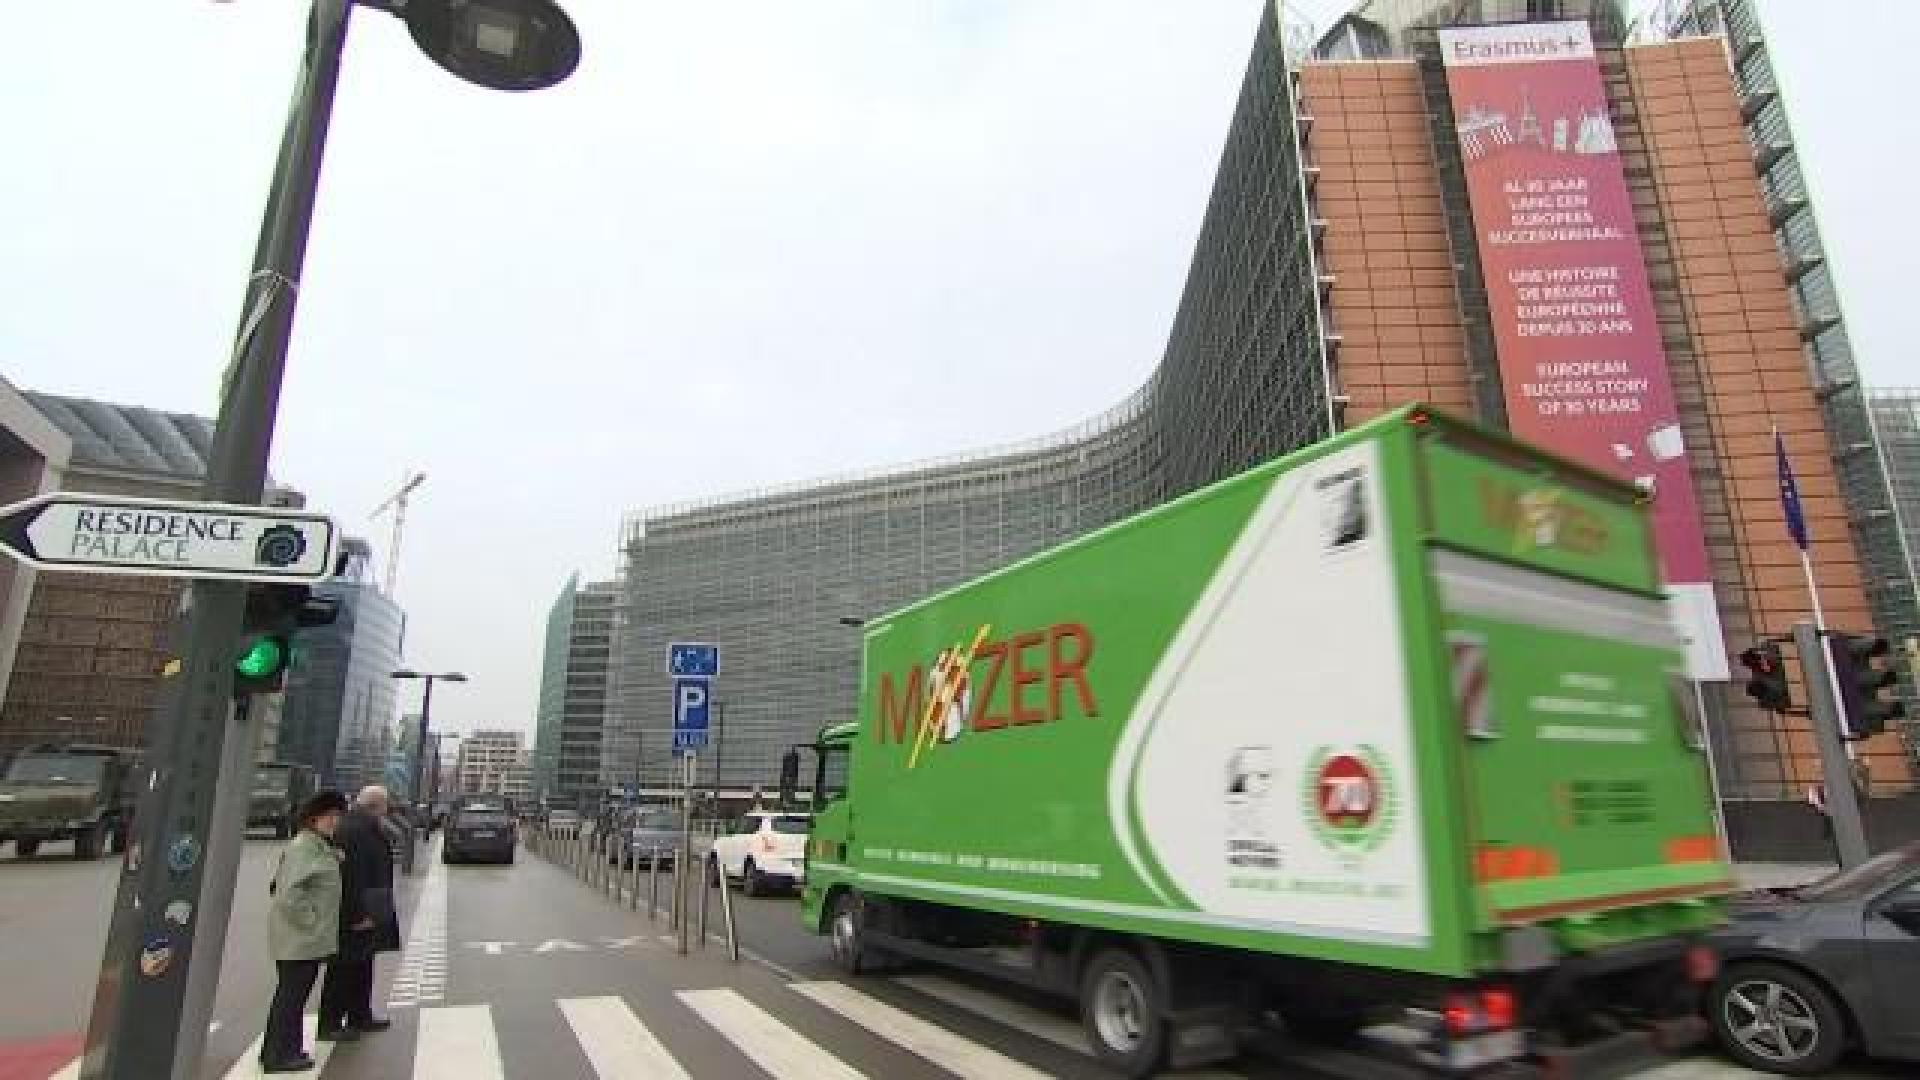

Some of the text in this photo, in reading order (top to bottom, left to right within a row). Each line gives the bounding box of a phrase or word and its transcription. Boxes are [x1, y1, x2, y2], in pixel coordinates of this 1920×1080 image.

[1454, 35, 1581, 58] Erasmus+
[1599, 319, 1632, 333] ANS
[1536, 361, 1628, 376] EUROPEAN
[1522, 382, 1593, 397] SUCCESS
[1538, 402, 1559, 415] OF
[1586, 398, 1640, 412] YEARS
[76, 509, 247, 541] RESIDENCE
[72, 533, 191, 562] PALACE
[680, 687, 706, 721] P
